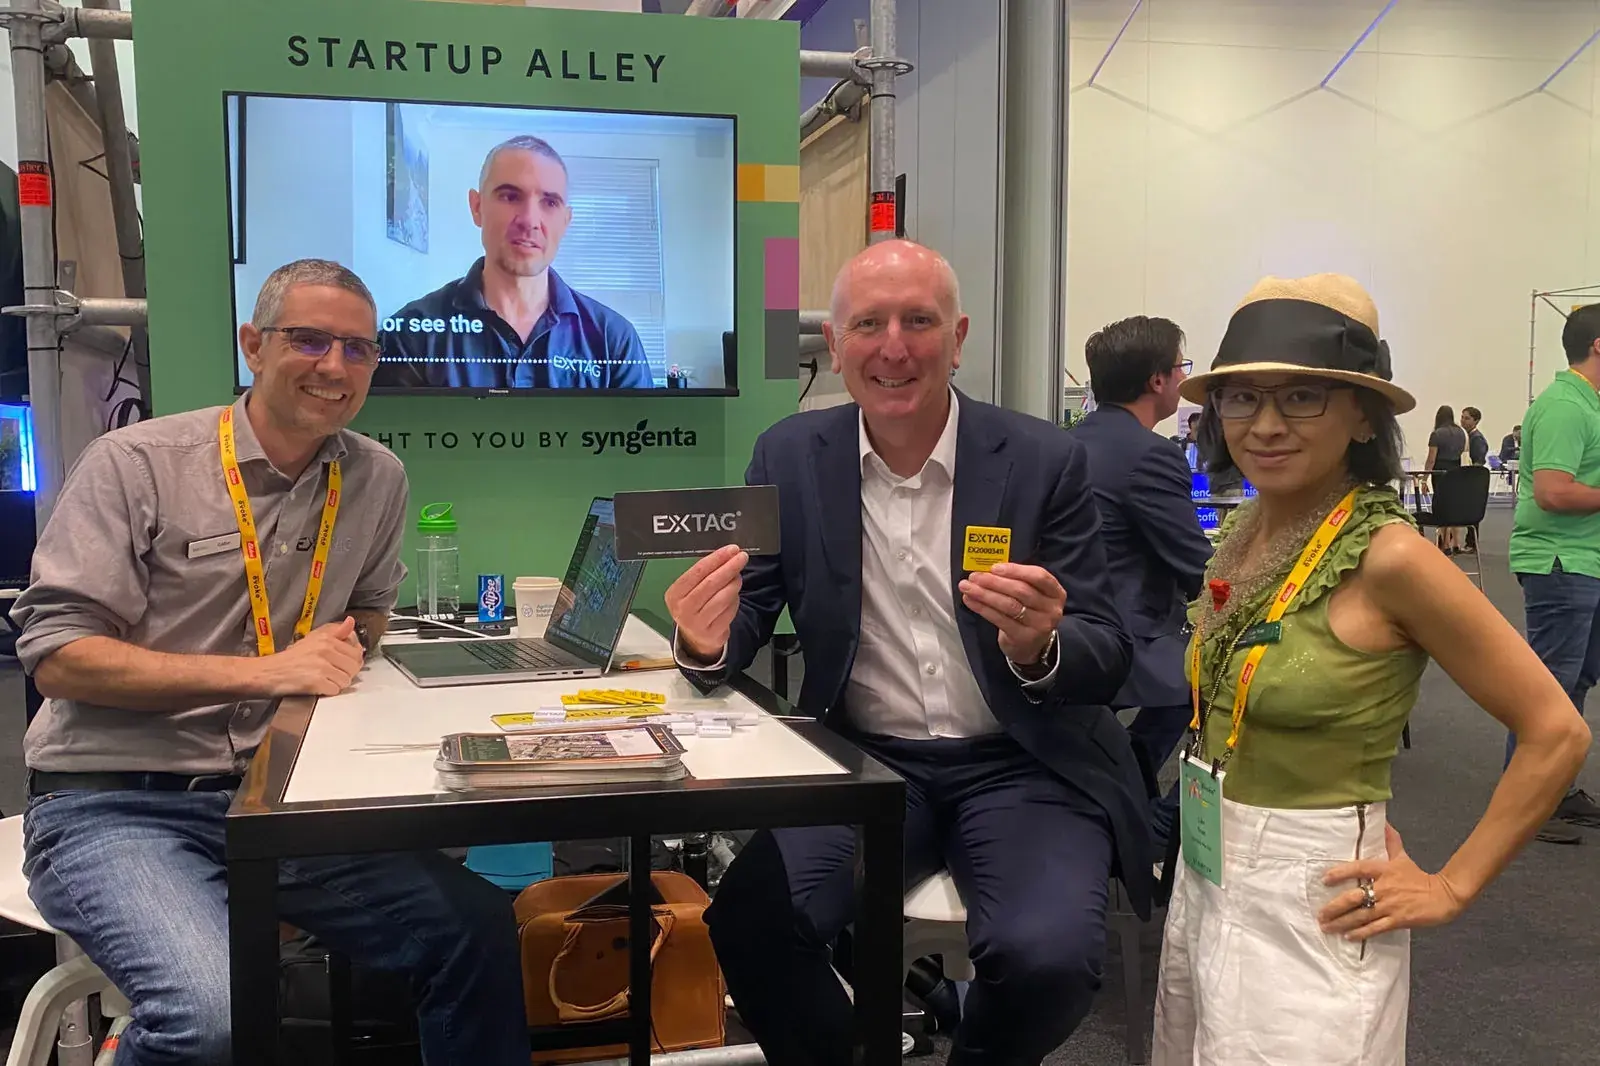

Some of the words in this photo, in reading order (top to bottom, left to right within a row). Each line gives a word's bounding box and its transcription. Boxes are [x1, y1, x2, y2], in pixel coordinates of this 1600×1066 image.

[287, 35, 502, 76] STARTUP
[526, 48, 667, 83] ALLEY
[382, 317, 405, 332] or
[409, 318, 445, 333] see
[451, 314, 483, 334] the
[553, 355, 602, 378] EXTAG
[424, 432, 459, 449] TO
[472, 432, 525, 449] YOU
[539, 432, 569, 449] BY
[581, 426, 697, 456] syngenta
[968, 533, 1008, 544] EXTAG
[485, 579, 498, 618] eclipse
